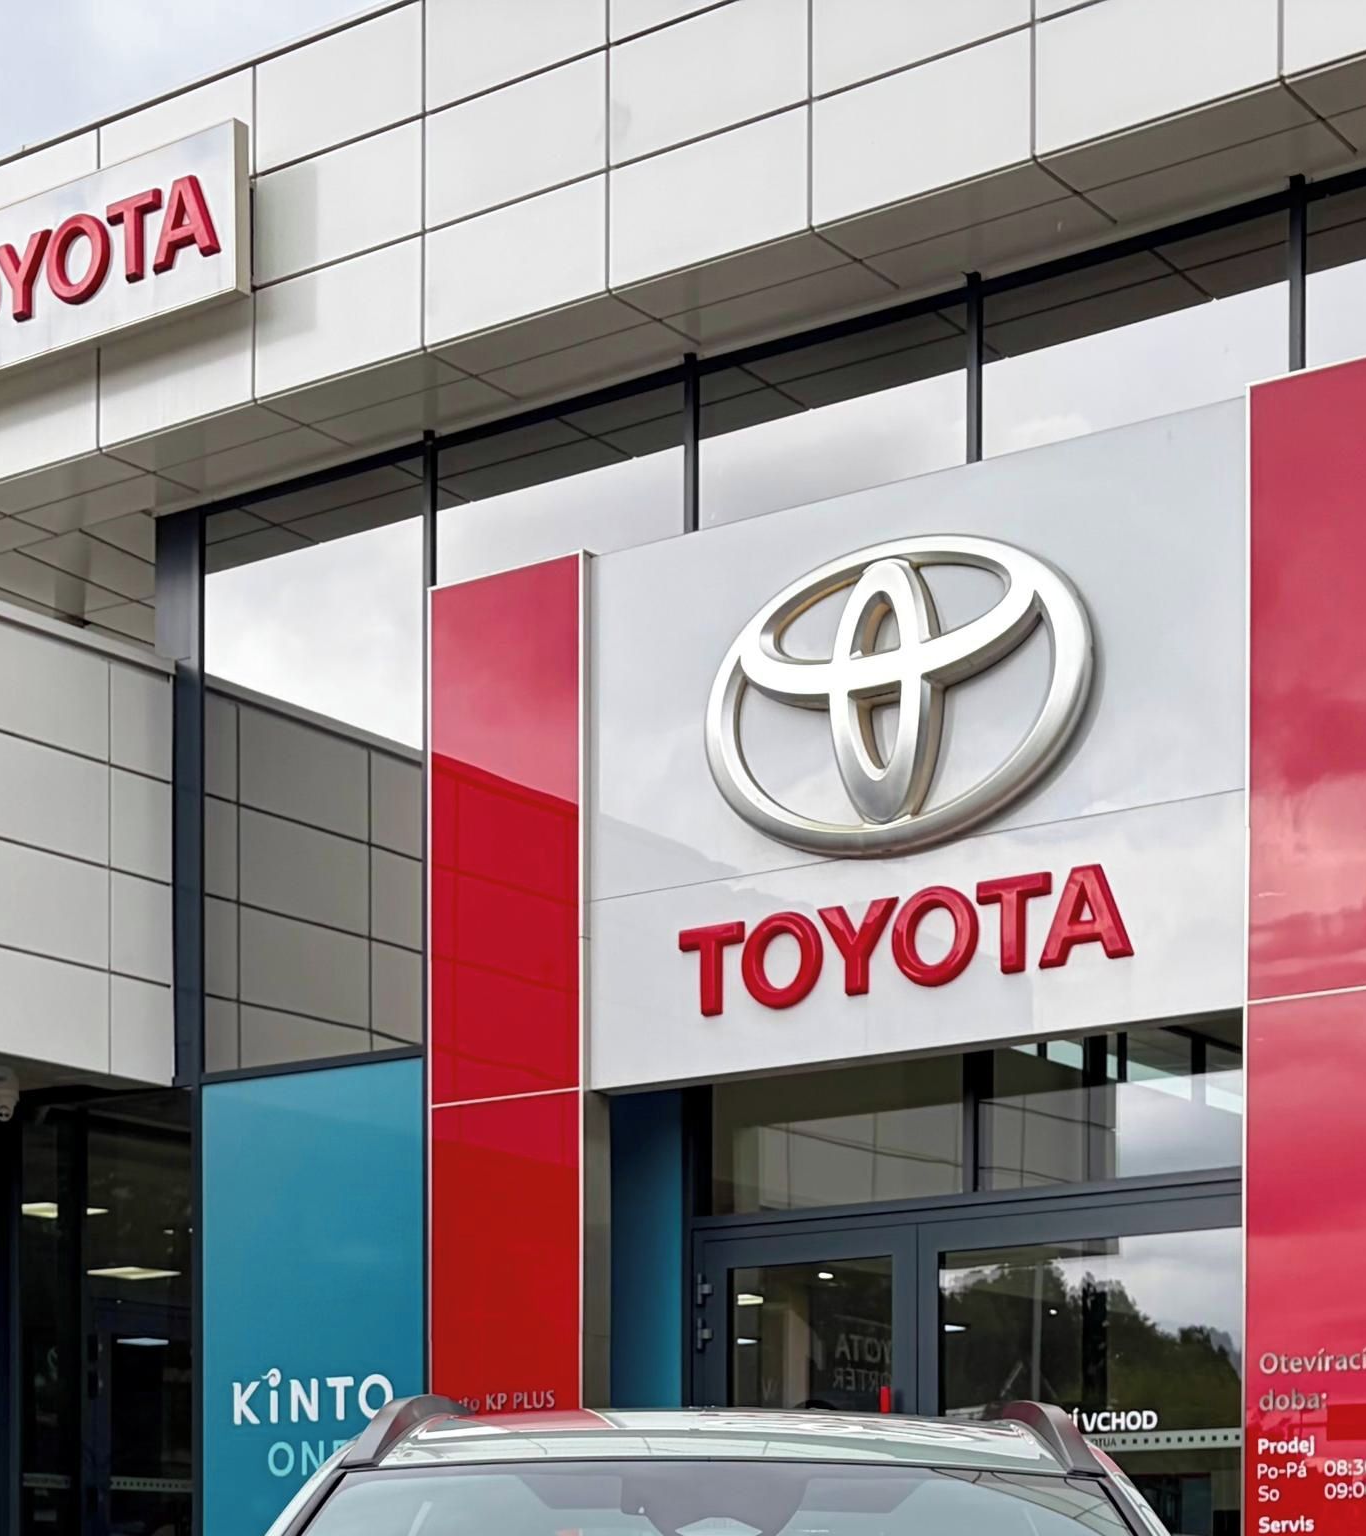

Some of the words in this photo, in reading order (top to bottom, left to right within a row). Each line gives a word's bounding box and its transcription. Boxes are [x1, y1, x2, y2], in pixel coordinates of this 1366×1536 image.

[679, 864, 1135, 1017] TOYOTA
[486, 1392, 508, 1411] KP
[513, 1389, 555, 1410] PLUS
[1259, 1389, 1328, 1412] doba:
[1082, 1410, 1158, 1432] VCHOD
[1257, 1435, 1316, 1457] Prodej
[1257, 1461, 1307, 1480] Po-Pá
[1258, 1485, 1280, 1502] So
[1258, 1515, 1315, 1534] Servis
